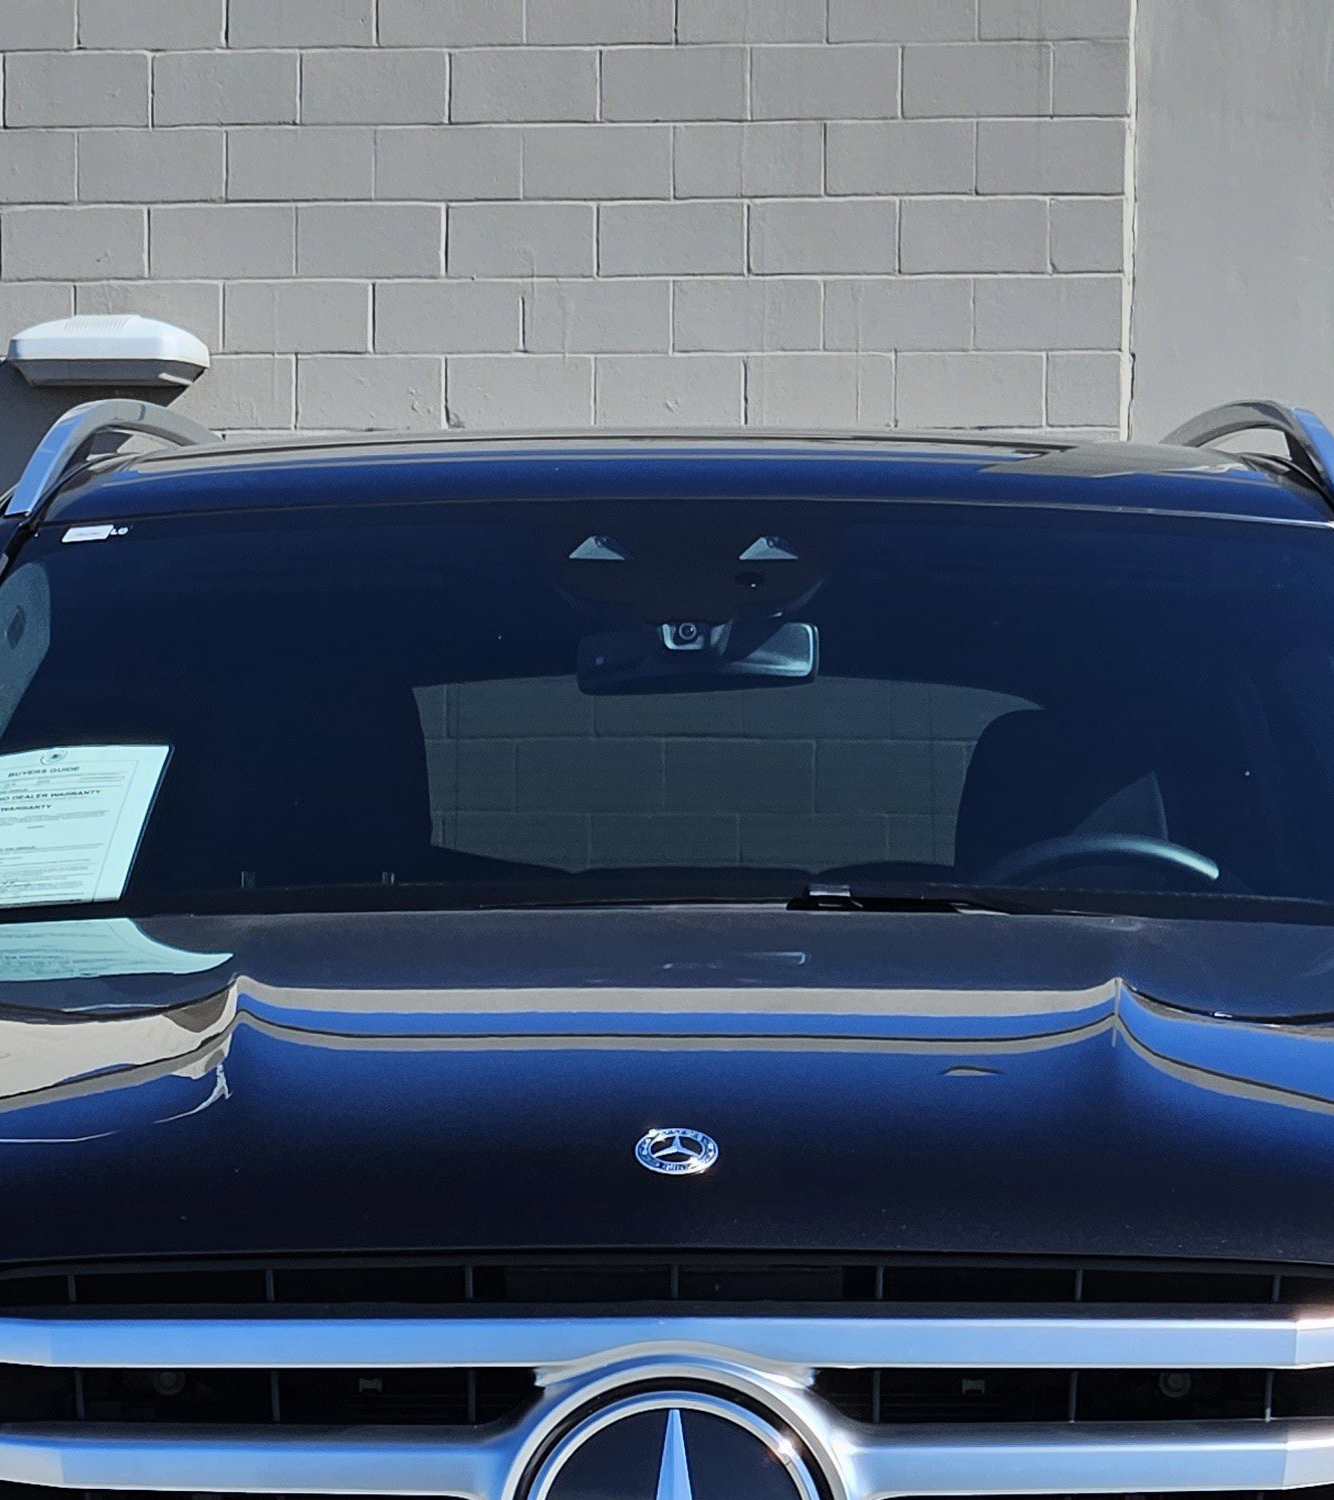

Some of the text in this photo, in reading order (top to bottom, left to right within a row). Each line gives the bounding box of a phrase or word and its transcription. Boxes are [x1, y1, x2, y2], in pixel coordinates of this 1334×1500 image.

[49, 766, 80, 774] GUIDE
[12, 793, 48, 801] DEALER
[50, 789, 102, 798] WARRANTY
[0, 804, 52, 812] WARRANTY
